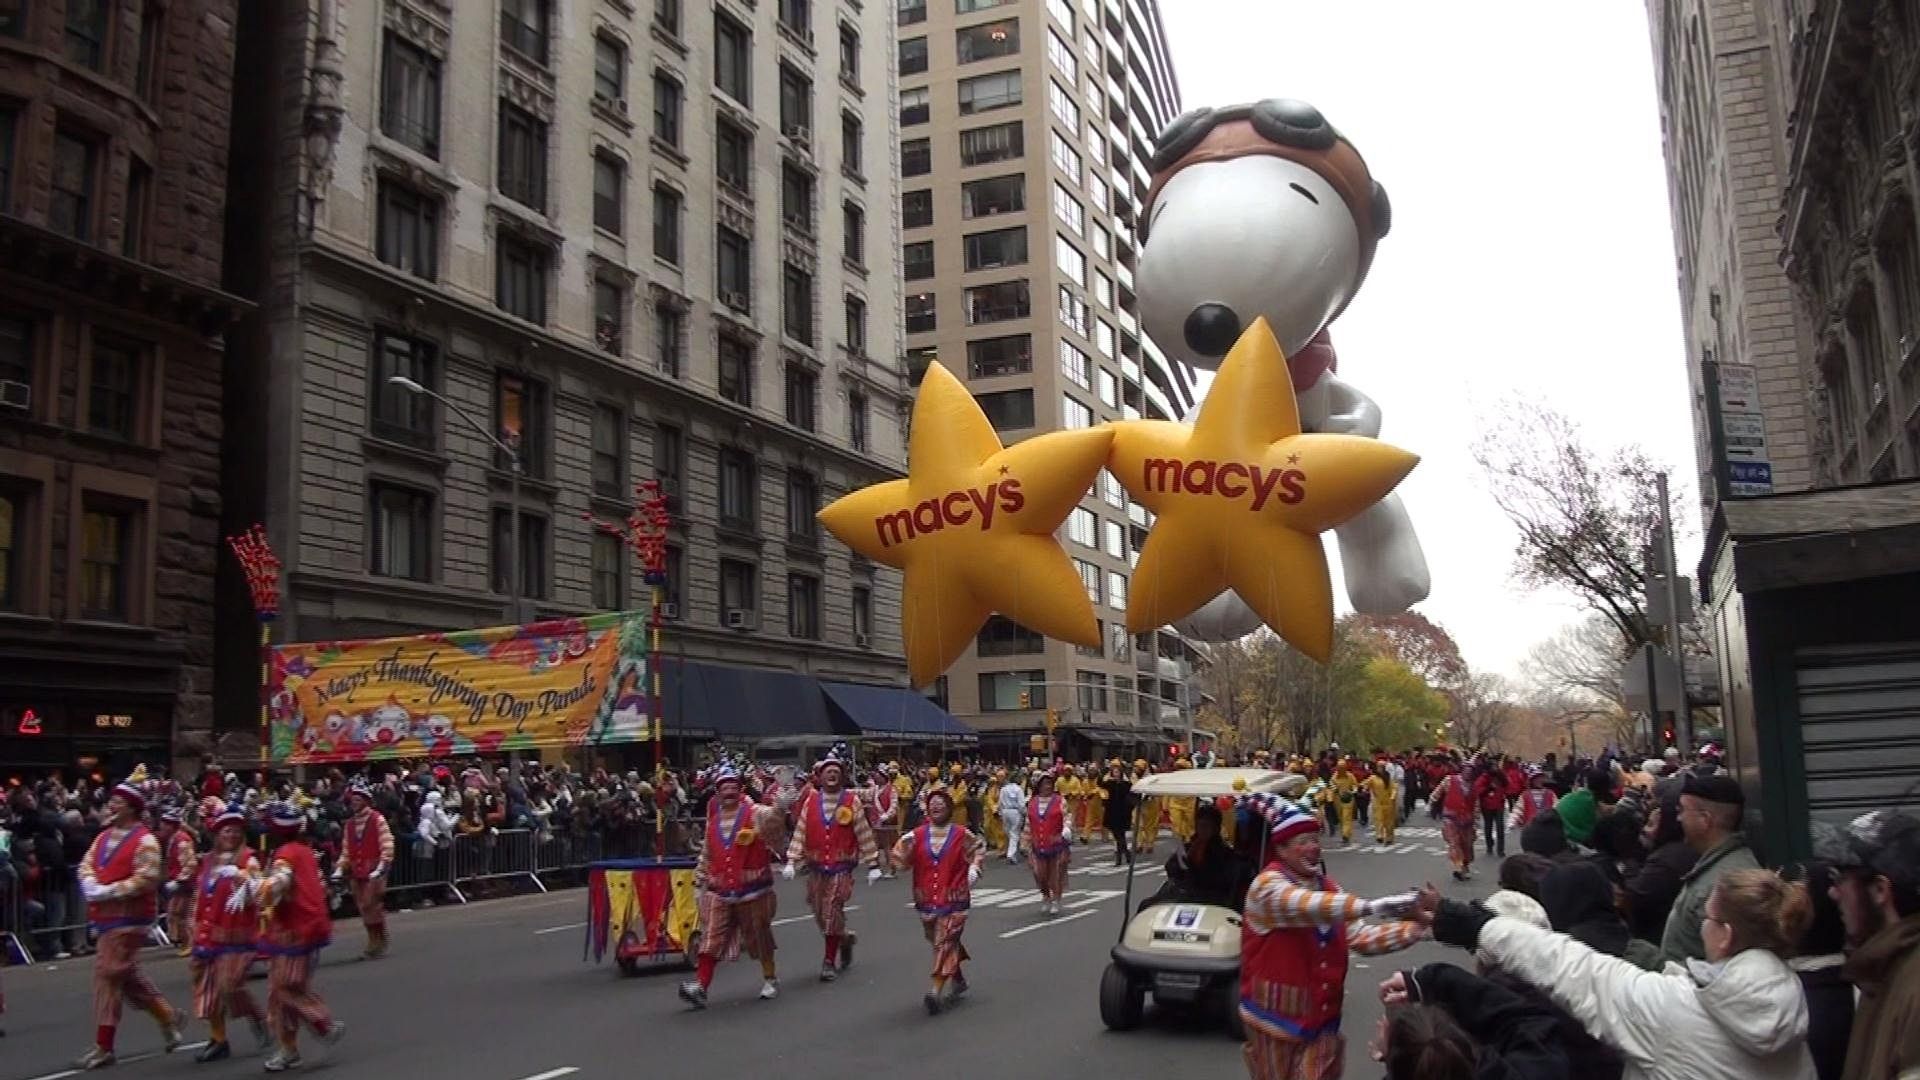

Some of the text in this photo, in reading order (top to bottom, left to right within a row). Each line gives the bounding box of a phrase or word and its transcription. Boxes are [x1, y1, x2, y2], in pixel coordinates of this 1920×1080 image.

[313, 646, 596, 734] Macy's Thanksgiving Day Parade
